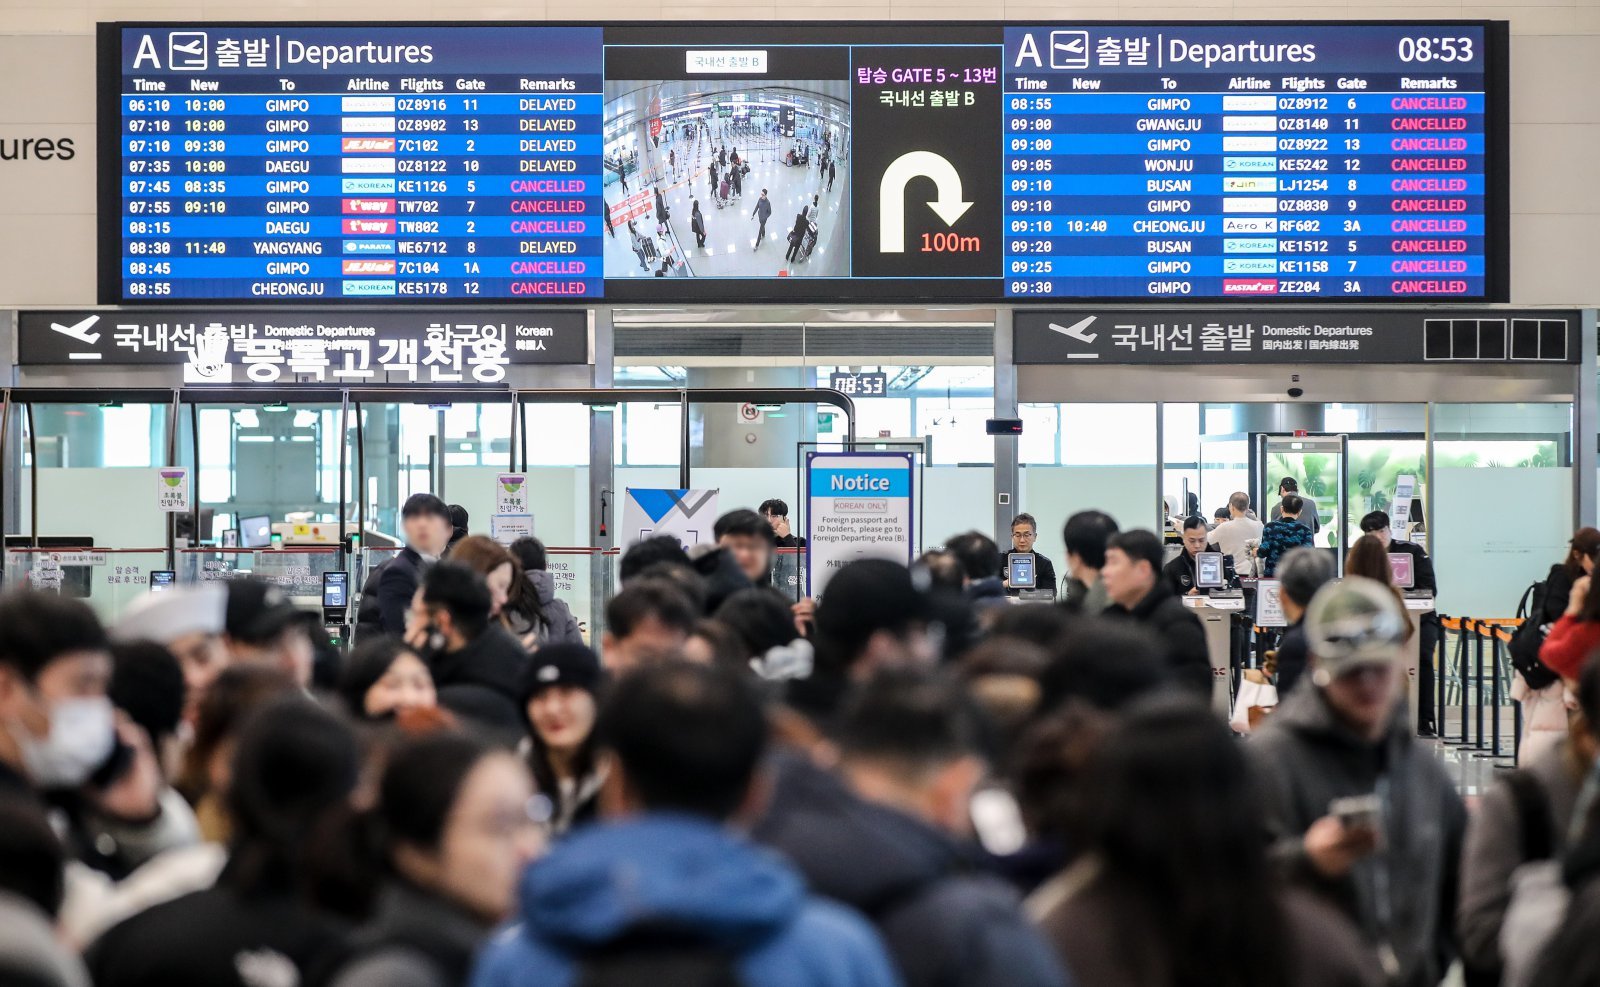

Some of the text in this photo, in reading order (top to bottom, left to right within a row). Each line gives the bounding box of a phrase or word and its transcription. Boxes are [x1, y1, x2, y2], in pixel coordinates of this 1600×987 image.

[133, 35, 161, 68] A
[215, 38, 270, 67] 출발
[288, 41, 433, 69] Departures
[1015, 34, 1042, 67] A
[1096, 37, 1150, 65] 출발
[1170, 40, 1315, 68] Departures
[1399, 38, 1473, 62] 08:53
[694, 56, 749, 68] 국내선 출발
[858, 67, 996, 84] 탑승 GATE 5 13번
[133, 78, 575, 93] Time New Airline Flights Gate Remarks
[1015, 77, 1457, 92] Time New Airline Flights Gate Remarks
[130, 100, 170, 111] 06:10
[186, 100, 225, 111] 10:00
[266, 100, 308, 111] GIMPO
[398, 99, 446, 110] OZ8916
[520, 99, 575, 110] DELAYED
[880, 90, 960, 107] 국내선 출발
[1012, 98, 1466, 110] 08:55 GIMPO OZ8912 CANCELLED
[130, 120, 169, 131] 07:10
[185, 120, 225, 131] 10:00
[266, 120, 309, 132] GIMPO
[398, 120, 446, 131] OZ8902
[520, 120, 576, 131] DELAYED
[1012, 119, 1051, 130] 09:00
[1137, 119, 1201, 131] GWANGJU
[1279, 119, 1328, 130] OZ8140
[1391, 118, 1467, 130] CANCELLED
[130, 140, 576, 152] 07:10 09:30 GIMPO 7C102 DELAYED
[1012, 138, 1467, 151] 09:00 GIMPO OZ8922 CANCELLED
[130, 161, 170, 172] 07:35
[186, 161, 225, 172] 10:00
[266, 161, 309, 172] DAEGU
[398, 160, 446, 171] OZ8122
[520, 160, 576, 171] DELAYED
[1012, 159, 1467, 171] 09:05 WONJU KE5242 CANCELLED
[130, 180, 585, 193] 07:45 08:35 GIMPO KE1126 CANCELLED
[1012, 179, 1467, 191] 09:10 BUSAN LJ1254 CANCELLED
[130, 201, 585, 213] 07:55 09:10 GIMPO TW702 CANCELLED
[1012, 200, 1051, 211] 09:10
[1148, 200, 1190, 212] GIMPO
[1279, 200, 1328, 211] OZ8030
[1391, 200, 1467, 212] CANCELLED
[130, 221, 585, 234] 08:15 DAEGU TW802 CANCELLED
[1012, 220, 1466, 232] 09:10 10:40 CHEONGJU RF602 CANCELLED
[130, 242, 576, 254] 08:30 11:40 YANGYANG WE6712 DELAYED
[922, 233, 979, 251] 100m
[1012, 240, 1467, 253] 09:20 BUSAN KE1512 CANCELLED
[130, 262, 585, 274] 08:45 GIMPO 7C104 CANCELLED
[1012, 260, 1467, 273] 09:25 GIMPO KE1158 CANCELLED
[130, 282, 586, 295] 08:55 CHEONGJU KE5178 CANCELLED
[1012, 281, 1467, 293] 09:30 GIMPO ZE204 CANCELLED
[113, 323, 195, 352] 국내선
[264, 325, 375, 338] Domestic Departures
[515, 325, 553, 337] Korean
[1112, 324, 1254, 351] 국내선 출발
[1263, 325, 1372, 337] Domestic Departures
[834, 377, 884, 394] 08:53
[832, 474, 889, 490] Notice
[161, 499, 186, 507] 진입가능
[822, 517, 849, 526] Foreign
[841, 535, 875, 543] Departing
[894, 534, 907, 542] (B).
[547, 562, 568, 571] 바이오
